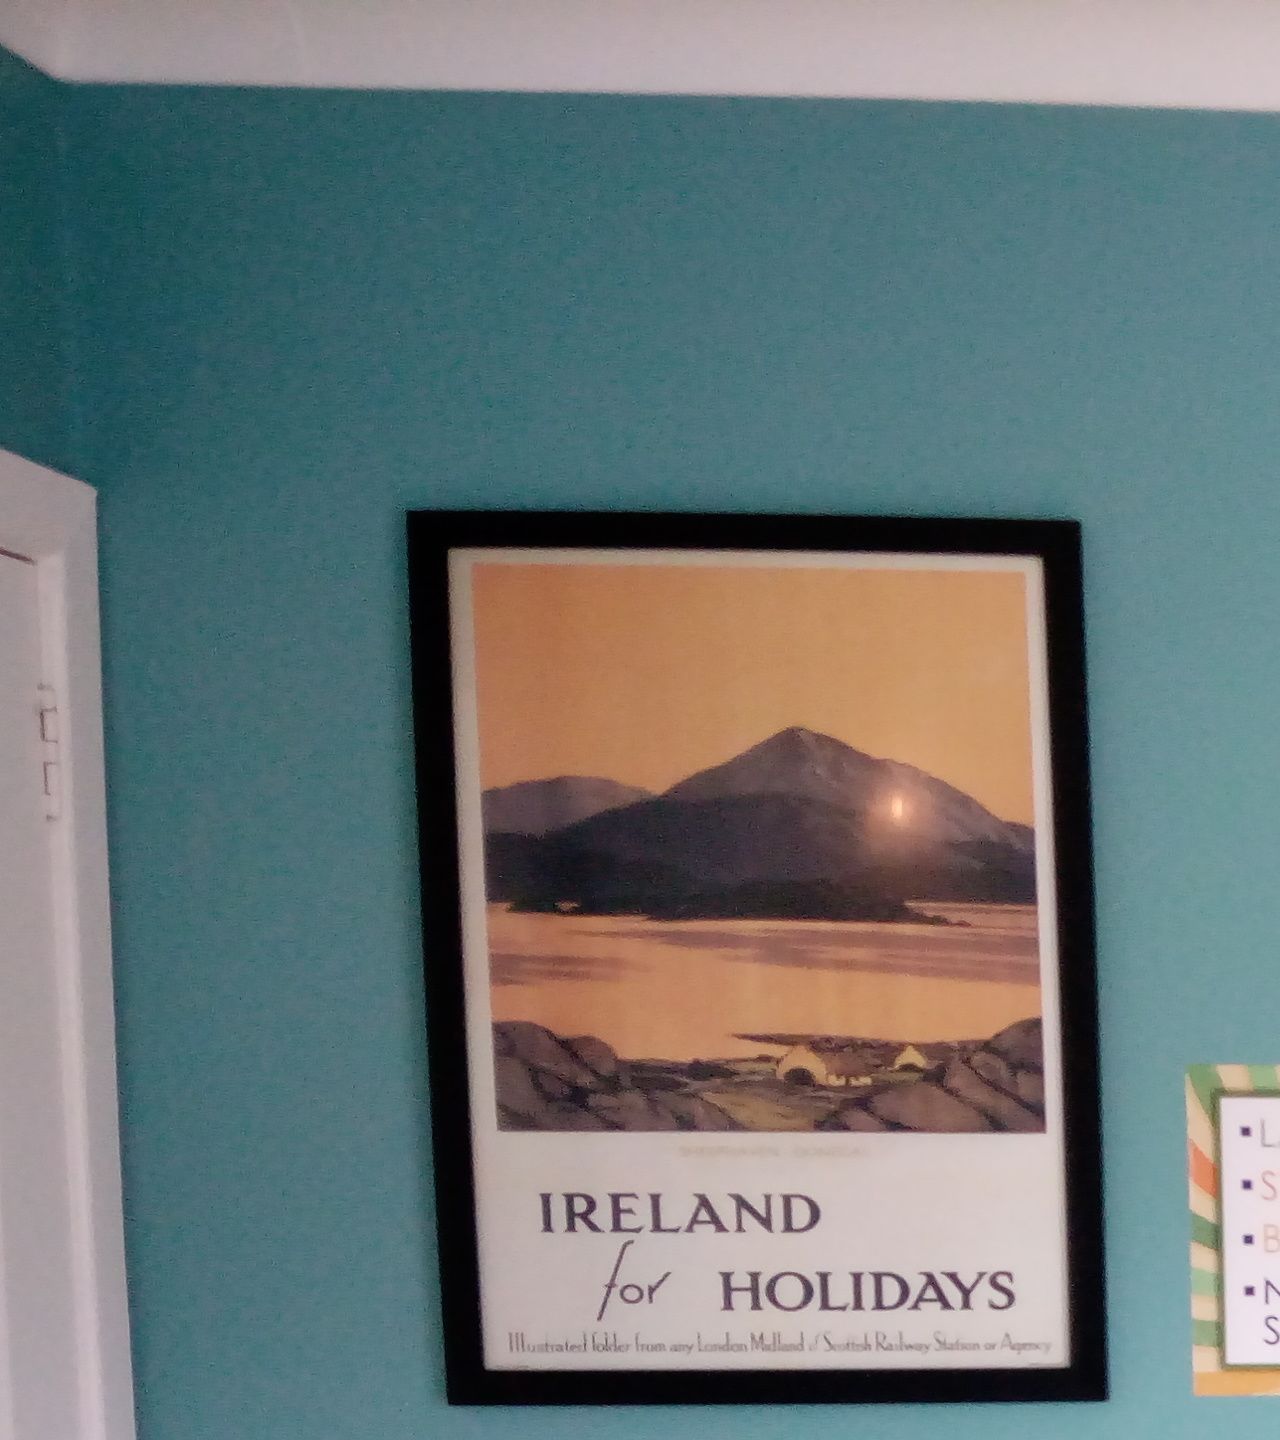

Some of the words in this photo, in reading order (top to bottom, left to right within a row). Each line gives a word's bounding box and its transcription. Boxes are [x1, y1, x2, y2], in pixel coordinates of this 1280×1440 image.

[538, 1192, 822, 1234] IRELAND
[596, 1239, 673, 1321] for
[718, 1270, 1018, 1312] HOLIDAYS
[508, 1331, 588, 1353] Illustrated
[592, 1331, 632, 1353] folder
[635, 1331, 667, 1353] from
